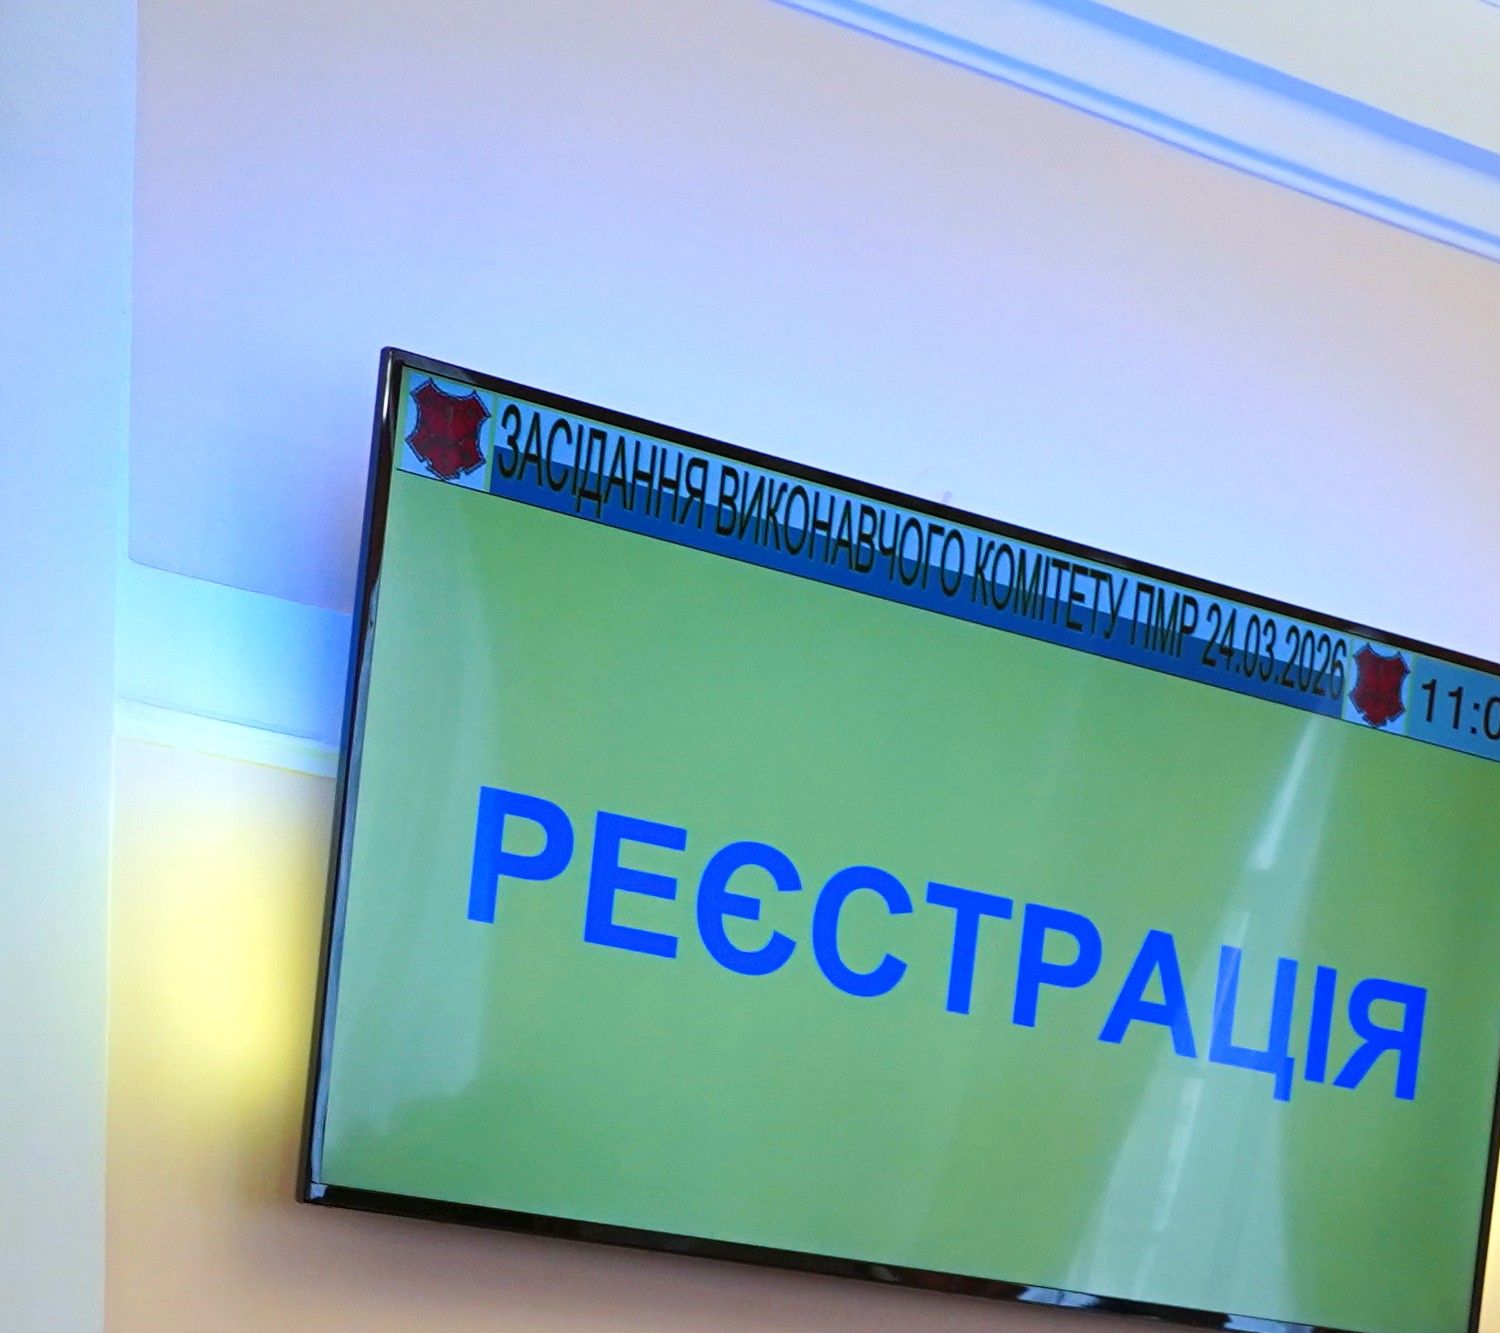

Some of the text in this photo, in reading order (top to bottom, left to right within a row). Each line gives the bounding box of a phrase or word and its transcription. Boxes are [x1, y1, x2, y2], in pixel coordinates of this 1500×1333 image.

[498, 404, 1348, 700] ЗАСІДАННЯ ВИКОНАВЧОГО КОМІТЕТУ ПМР 24.03.2026
[466, 785, 1428, 1103] РЕЄСТРАЦІЯ
